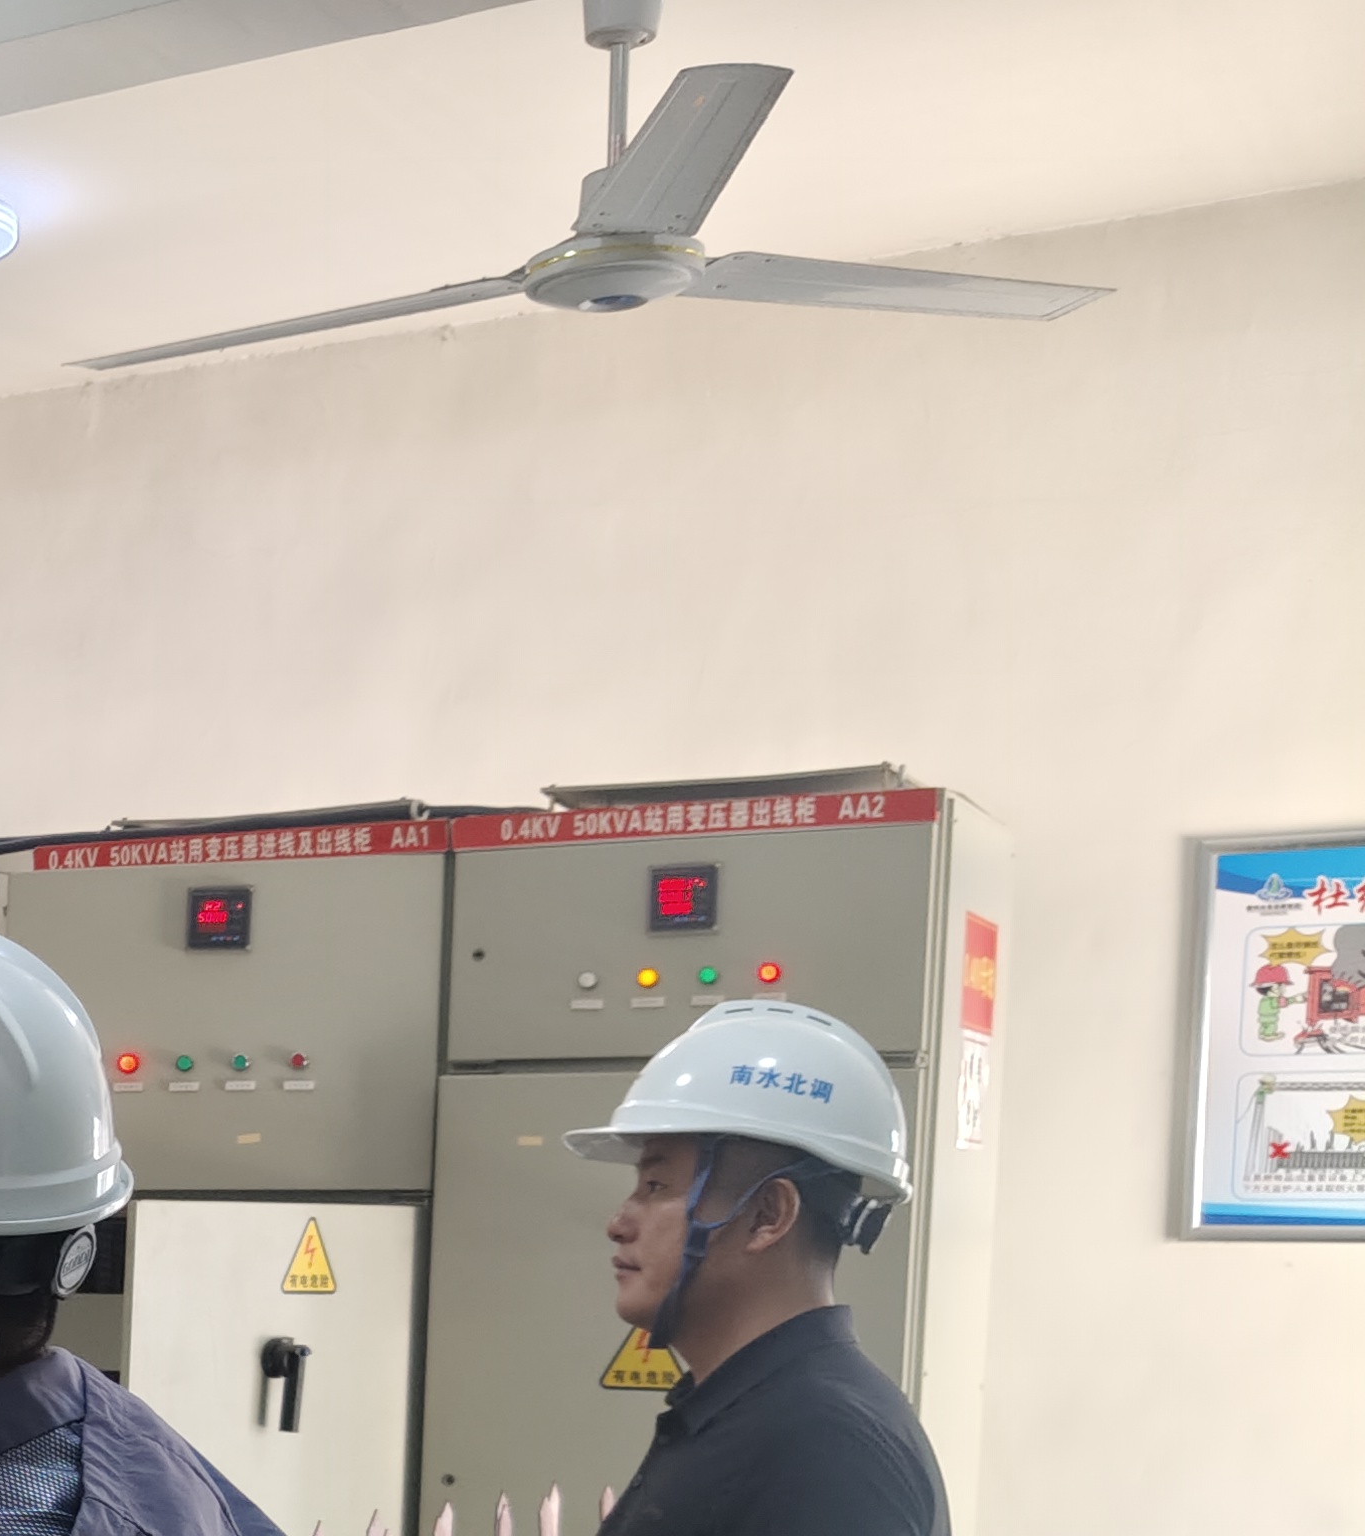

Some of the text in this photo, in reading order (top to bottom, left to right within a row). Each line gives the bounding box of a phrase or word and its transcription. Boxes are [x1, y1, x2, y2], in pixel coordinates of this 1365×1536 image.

[500, 795, 886, 841] 0.4KV 50KVA站用变压器出线柜 AA2
[48, 825, 430, 870] 0.4KV 50KVA站用变压器进线及出线柜 AA1
[1307, 876, 1365, 916] 杜
[730, 1063, 834, 1105] 南水北调
